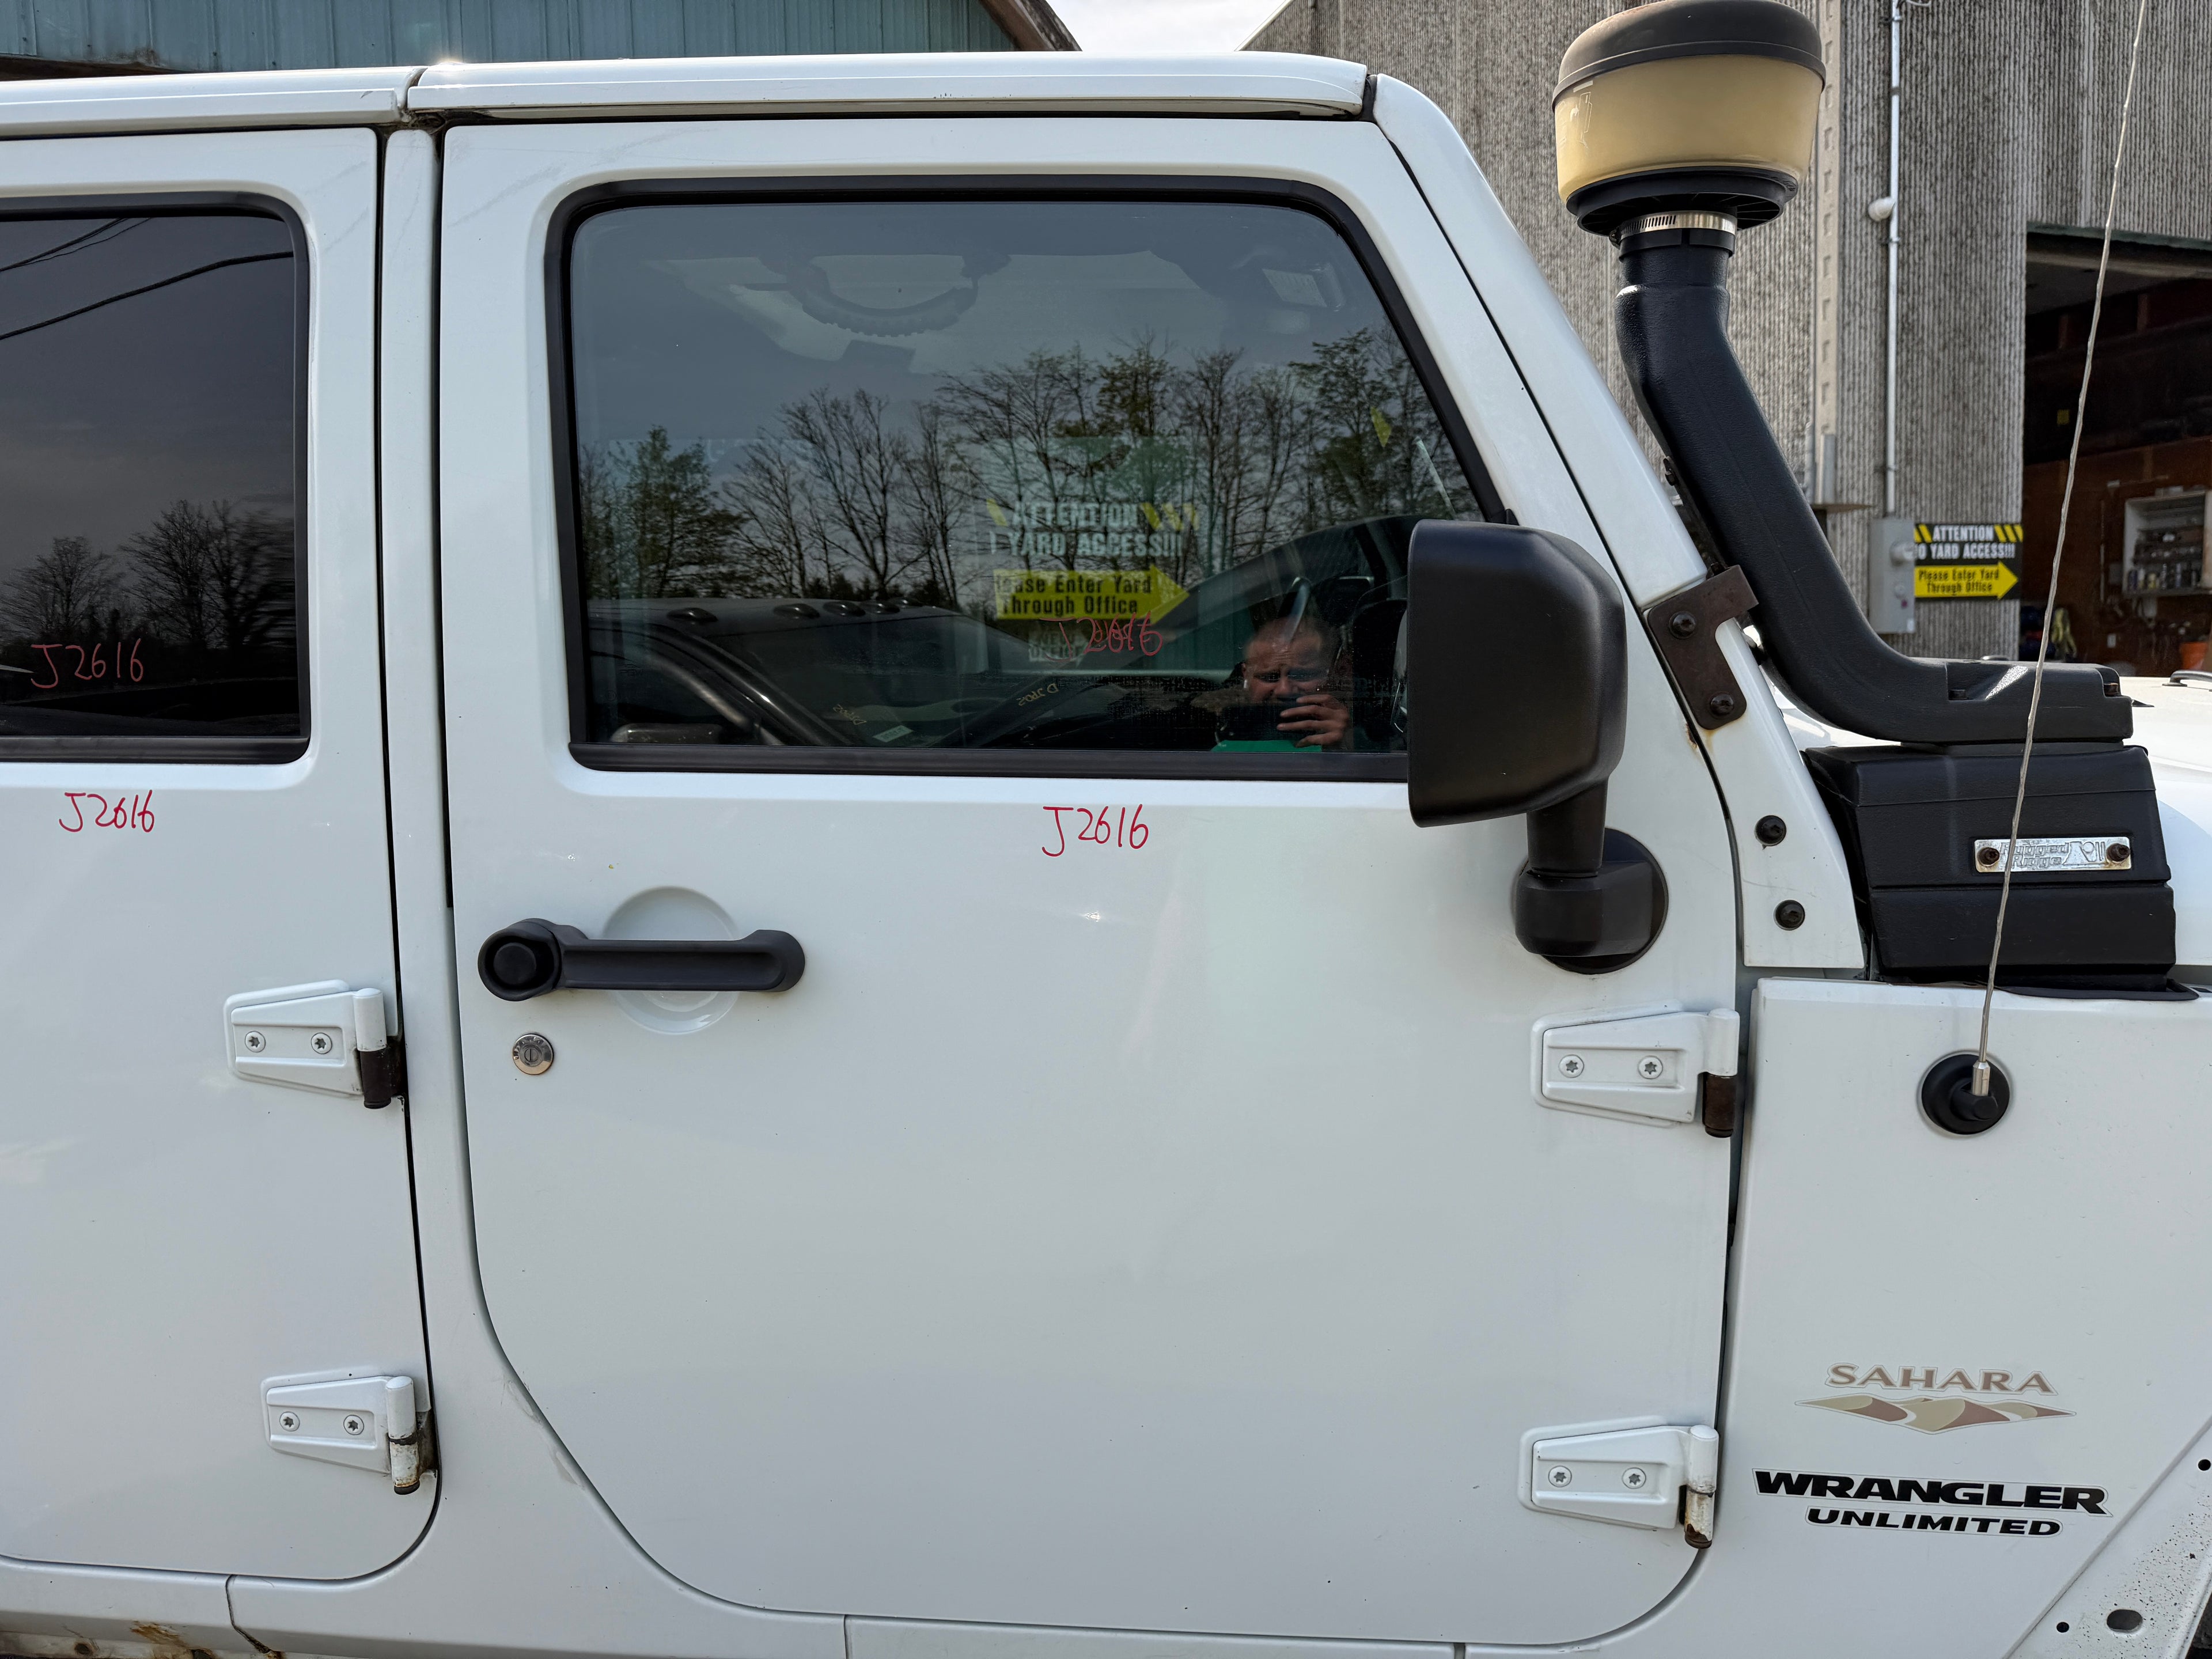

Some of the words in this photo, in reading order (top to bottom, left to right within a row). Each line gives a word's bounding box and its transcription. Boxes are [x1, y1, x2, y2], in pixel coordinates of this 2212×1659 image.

[1933, 525, 1994, 541] ATTENTION
[1009, 532, 1065, 556] YARD
[1930, 543, 1960, 559] YARD
[1962, 543, 2015, 559] ACCESS!!!
[1055, 574, 1103, 593] Enter
[1114, 574, 1152, 593] Yard
[1919, 569, 1949, 581] Please
[1952, 569, 1976, 579] Enter
[1980, 569, 1999, 579] Yard
[1927, 582, 1962, 594] Through
[1966, 582, 1993, 592] Office
[1084, 595, 1138, 615] Office
[31, 638, 144, 688] J2616
[59, 790, 155, 832] J2616
[1041, 804, 1149, 857] J2616
[1999, 842, 2069, 856] Rugged
[2012, 854, 2063, 869] Ridge
[1827, 1363, 2054, 1393] SAHARA
[1755, 1470, 2108, 1516] WRANGLER
[1806, 1508, 2061, 1536] UNLIMITED
